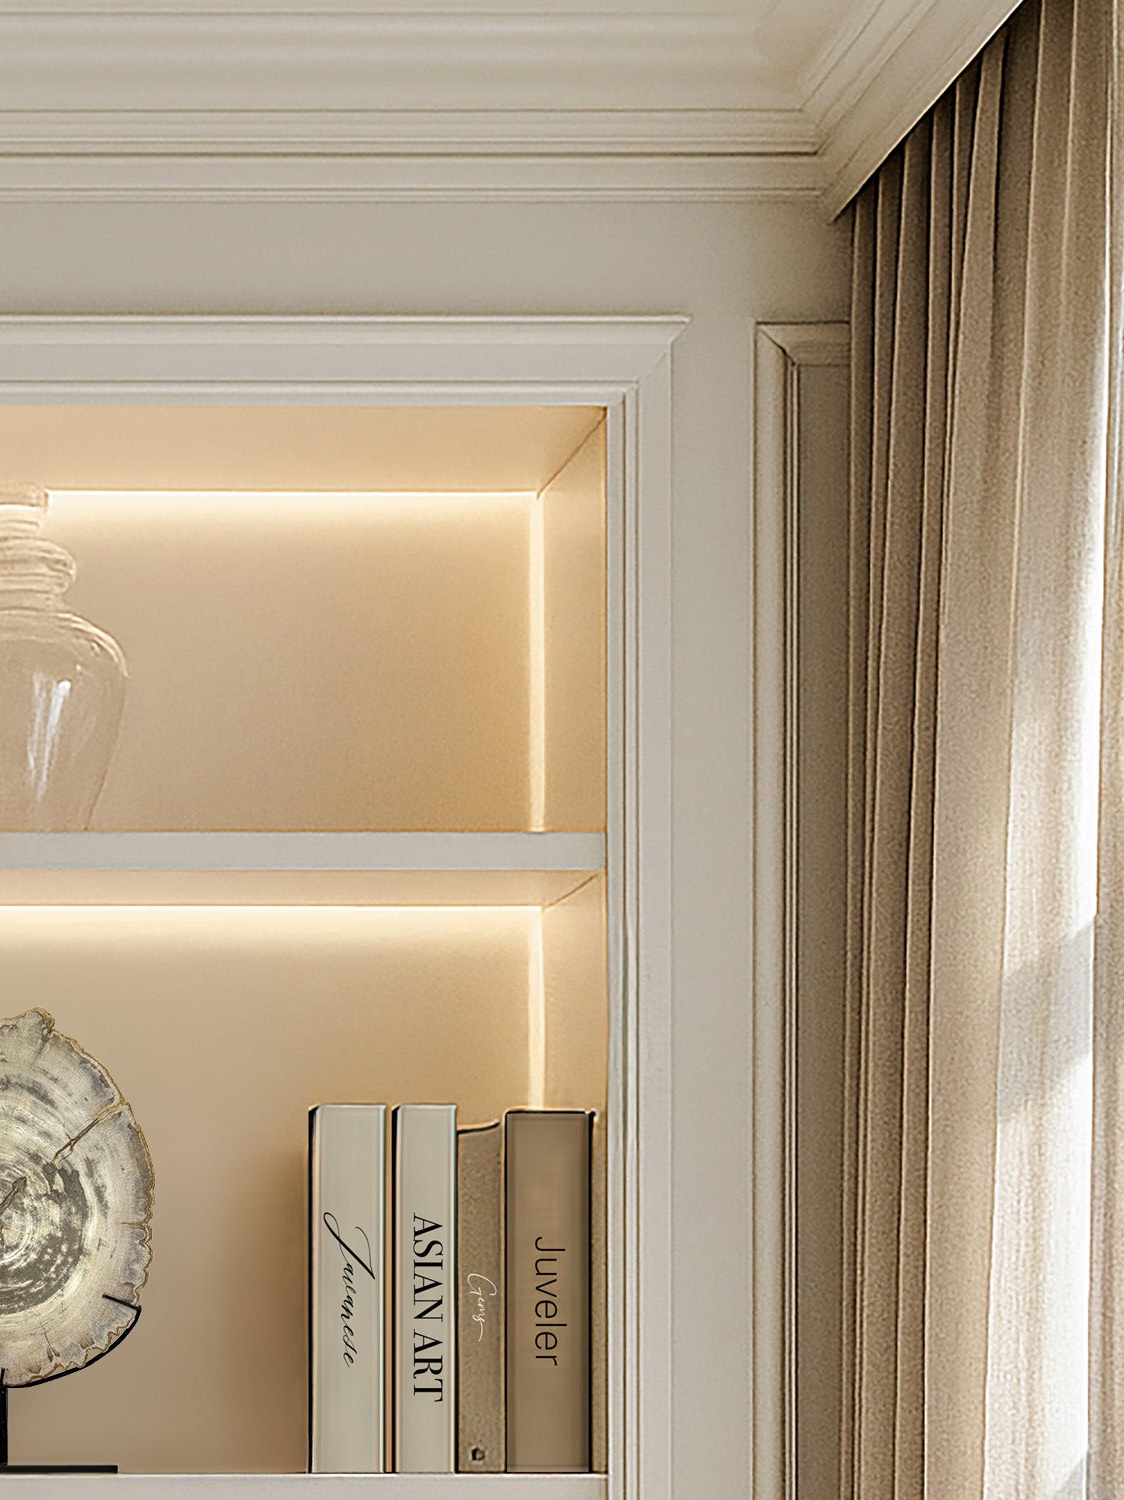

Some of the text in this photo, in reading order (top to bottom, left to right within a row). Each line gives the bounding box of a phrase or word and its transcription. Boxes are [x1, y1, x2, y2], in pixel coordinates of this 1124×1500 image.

[323, 1212, 375, 1368] Javanese
[412, 1213, 443, 1403] ASIAN ART
[534, 1236, 568, 1367] Juveler
